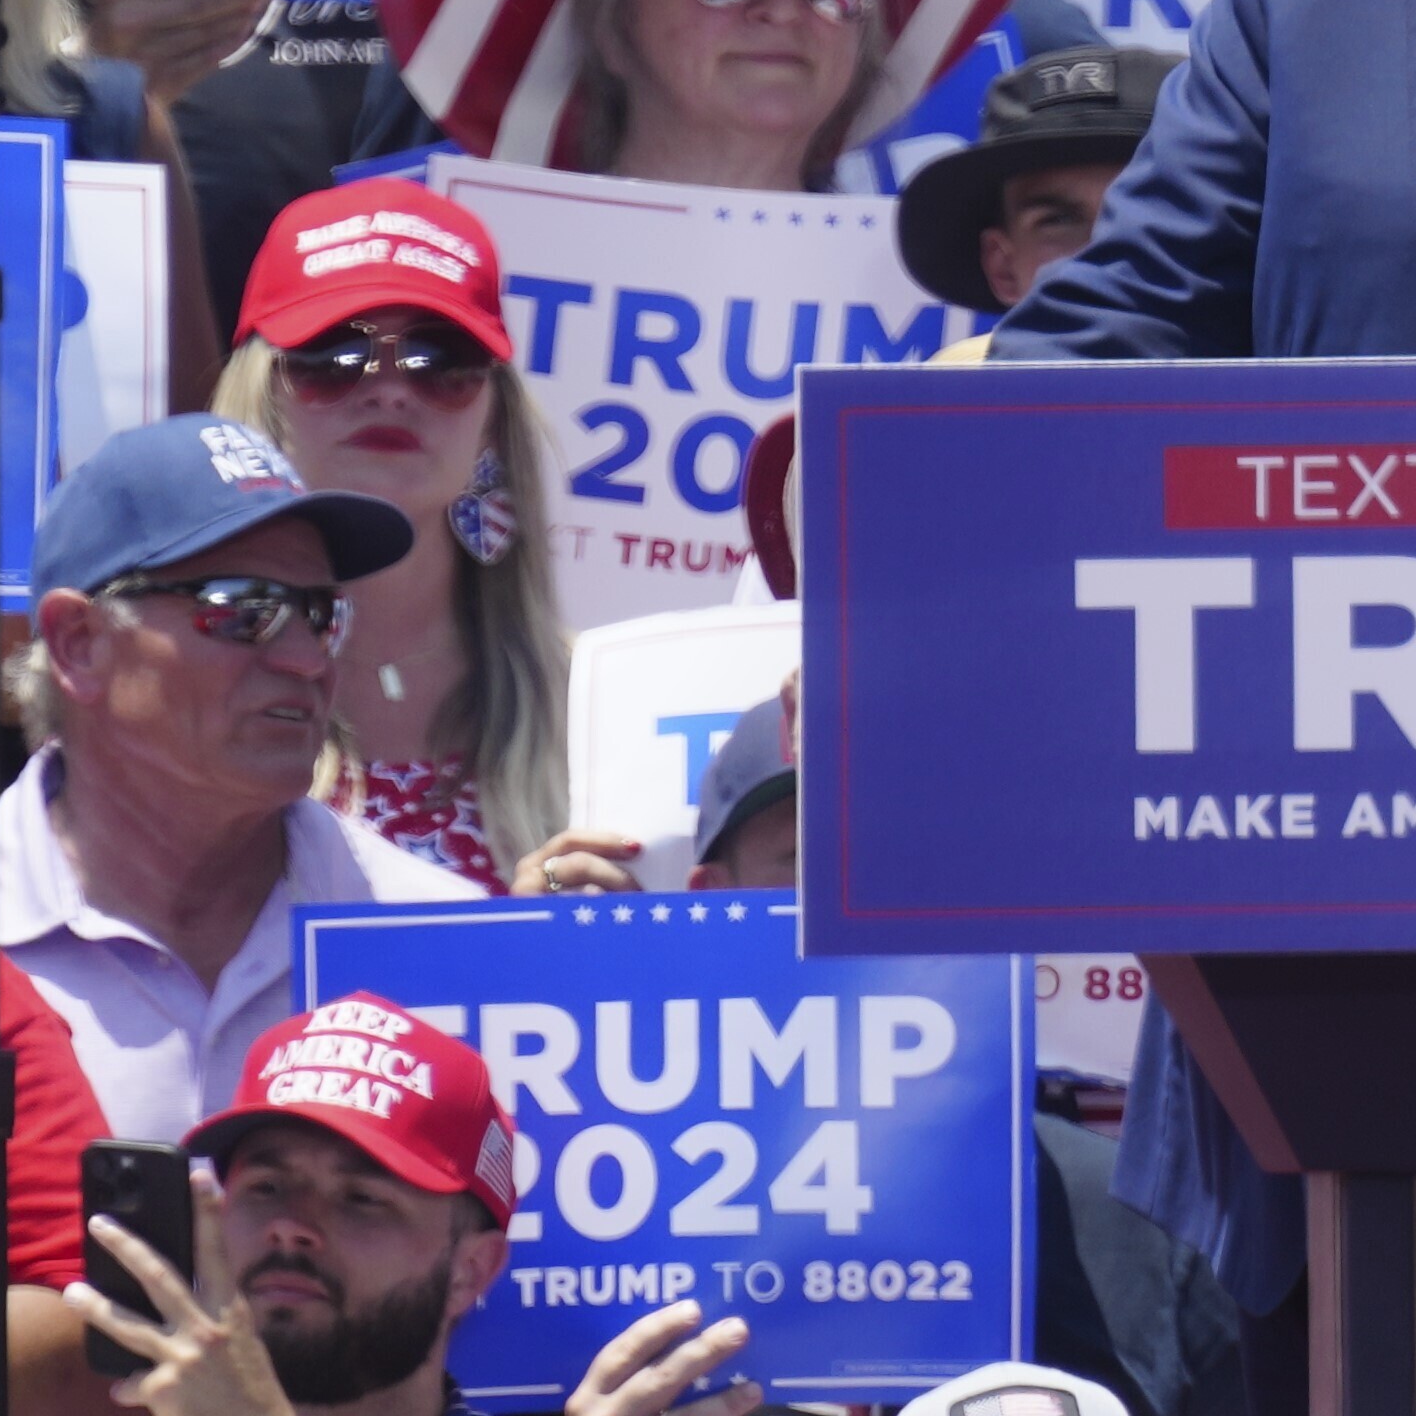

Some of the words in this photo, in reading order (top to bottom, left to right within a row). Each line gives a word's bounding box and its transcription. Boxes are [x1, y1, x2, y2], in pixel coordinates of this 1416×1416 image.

[1037, 61, 1110, 95] TYR
[501, 274, 984, 401] TRUM
[1132, 794, 1315, 841] MAKE
[302, 1000, 414, 1043] KEEP
[257, 1034, 434, 1101] AMERICA
[266, 1069, 404, 1120] GREAT
[510, 1262, 696, 1310] TRUMP
[712, 1261, 785, 1304] TO
[802, 1259, 974, 1303] 88022
